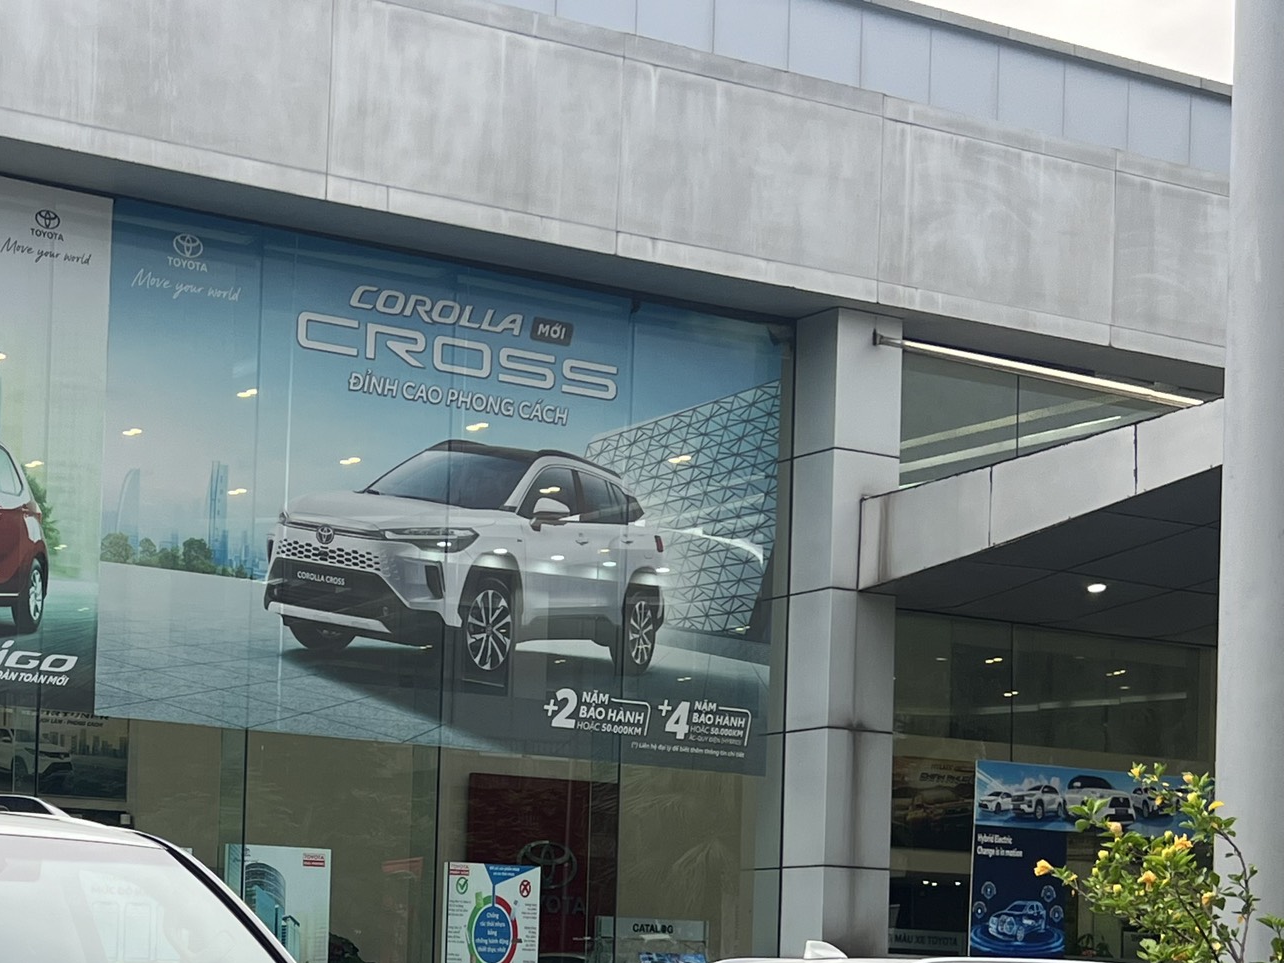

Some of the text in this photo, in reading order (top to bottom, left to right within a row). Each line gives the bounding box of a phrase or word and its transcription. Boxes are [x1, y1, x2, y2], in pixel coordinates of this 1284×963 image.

[30, 228, 64, 242] TOYOTA
[0, 237, 92, 265] Move your world
[167, 256, 208, 272] TOYOTA
[131, 268, 242, 301] Move your world
[349, 285, 567, 340] COROLLA MỚI
[297, 312, 619, 401] CROSS
[348, 370, 569, 425] ĐỈNH CAO PHONG CÁCH
[297, 570, 345, 586] COROLLA CROSS
[18, 672, 46, 684] TOÀN
[46, 674, 70, 686] MỚI
[582, 690, 610, 705] NĂM
[694, 700, 716, 712] NĂM
[544, 688, 578, 729] +2
[578, 703, 644, 724] BẢO HÀNH
[658, 700, 691, 740] +4
[692, 711, 746, 728] BẢO HÀNH
[601, 724, 642, 736] 50.000KM
[710, 726, 743, 738] 50.000KM
